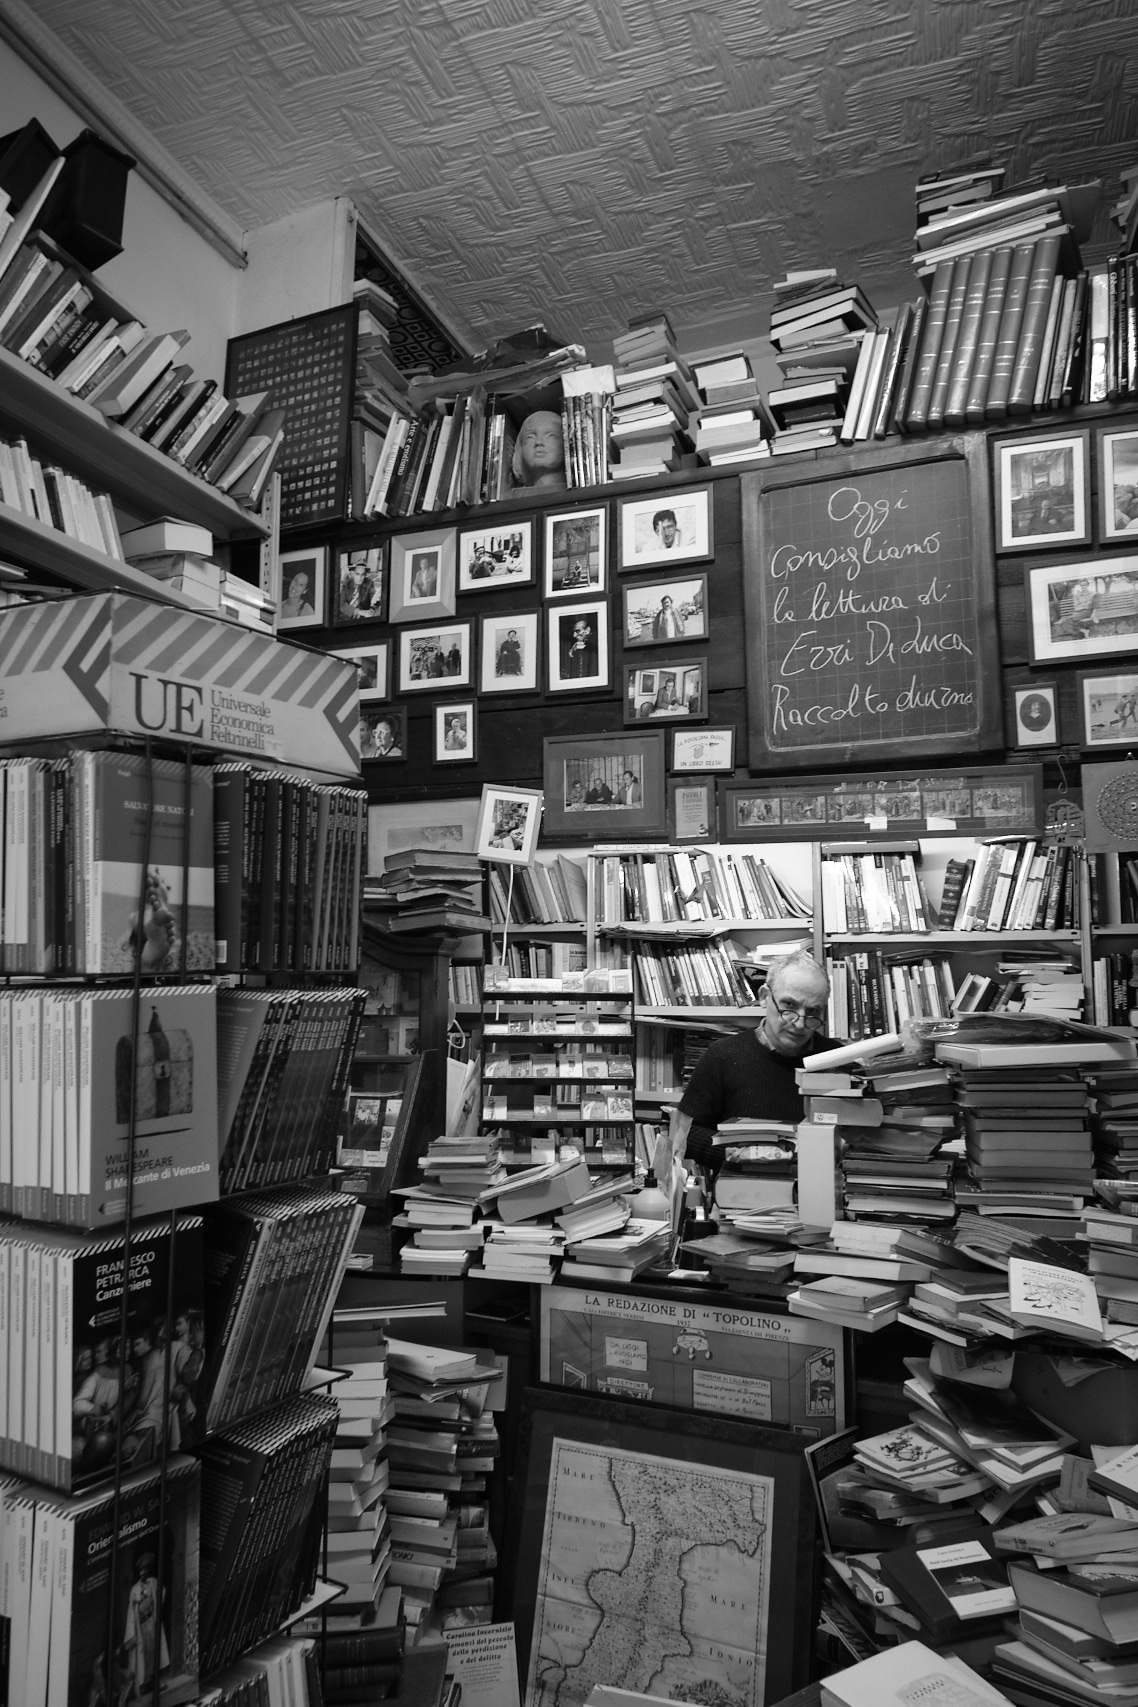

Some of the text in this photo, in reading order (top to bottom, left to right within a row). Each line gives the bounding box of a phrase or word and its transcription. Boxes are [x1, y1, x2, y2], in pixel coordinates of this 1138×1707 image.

[408, 420, 419, 436] Arte
[398, 444, 410, 476] erotismo
[828, 486, 908, 538] Oggi
[773, 576, 951, 623] la lettura di
[128, 672, 203, 738] UE
[210, 690, 271, 718] Universale
[772, 684, 888, 735] Raccolto
[210, 707, 274, 735] Economica
[210, 724, 265, 750] Feltrinelli
[105, 1149, 149, 1165] WILLAM
[105, 1156, 174, 1178] SHAESPEARE
[114, 1172, 159, 1189] Mecante
[161, 1168, 171, 1179] di
[172, 1162, 210, 1177] Venezia
[96, 1251, 155, 1277] FRANESCO
[585, 1295, 600, 1306] LA
[607, 1298, 677, 1317] REDAZIONE
[683, 1308, 696, 1319] DI
[610, 1378, 645, 1388] DIRETTORE
[563, 1466, 595, 1480] MARE
[710, 1595, 746, 1611] MARE
[446, 1630, 476, 1640] Carolina
[448, 1640, 475, 1648] omanzi
[488, 1635, 514, 1644] peccato
[471, 1644, 507, 1655] perdizione
